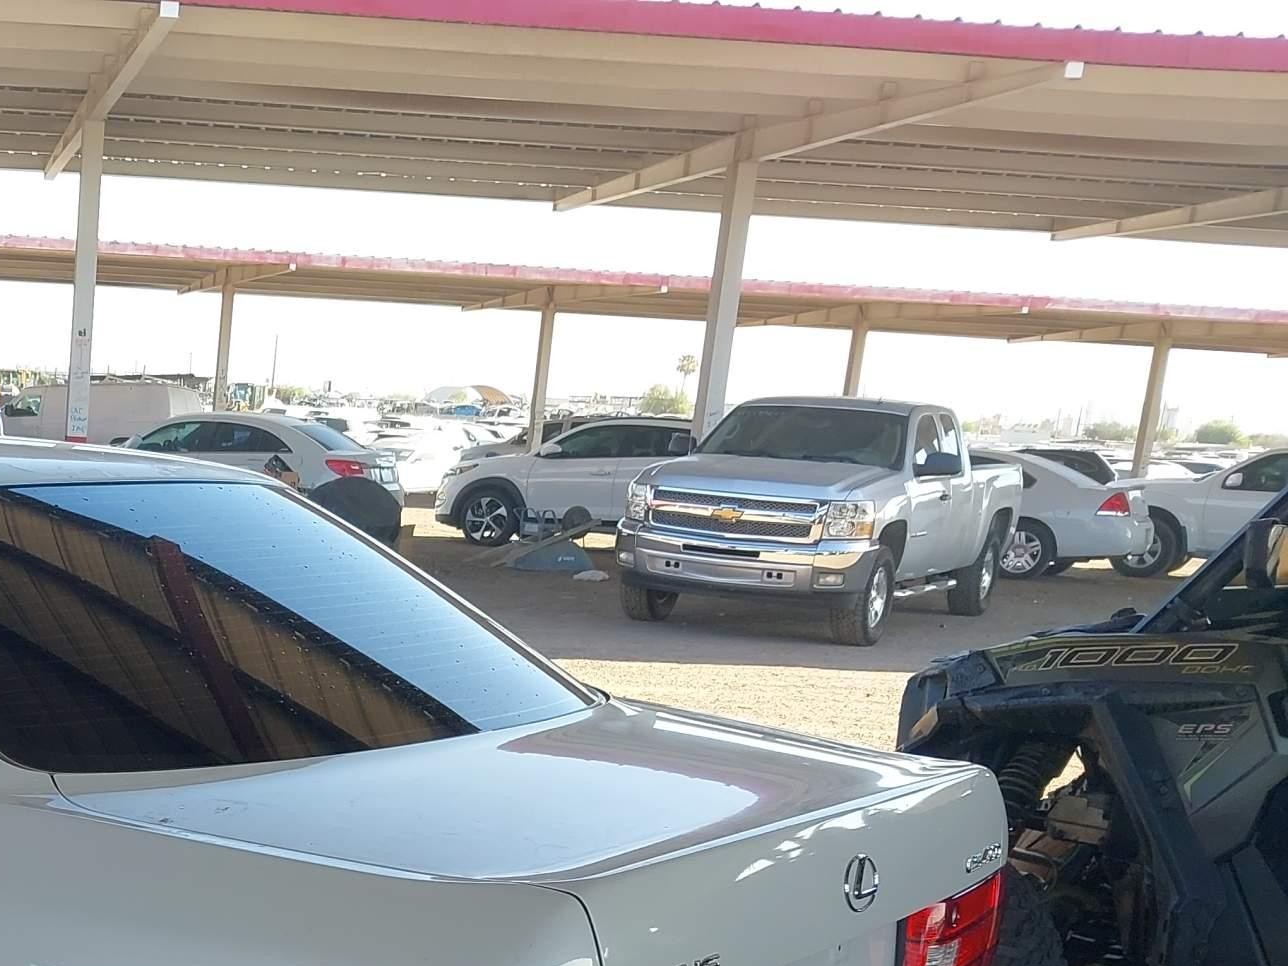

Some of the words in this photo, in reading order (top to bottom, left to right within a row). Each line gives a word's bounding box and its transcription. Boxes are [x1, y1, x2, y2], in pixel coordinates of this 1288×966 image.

[1038, 643, 1239, 672] 1000
[1181, 664, 1255, 674] DOHC
[1177, 721, 1235, 735] EPS
